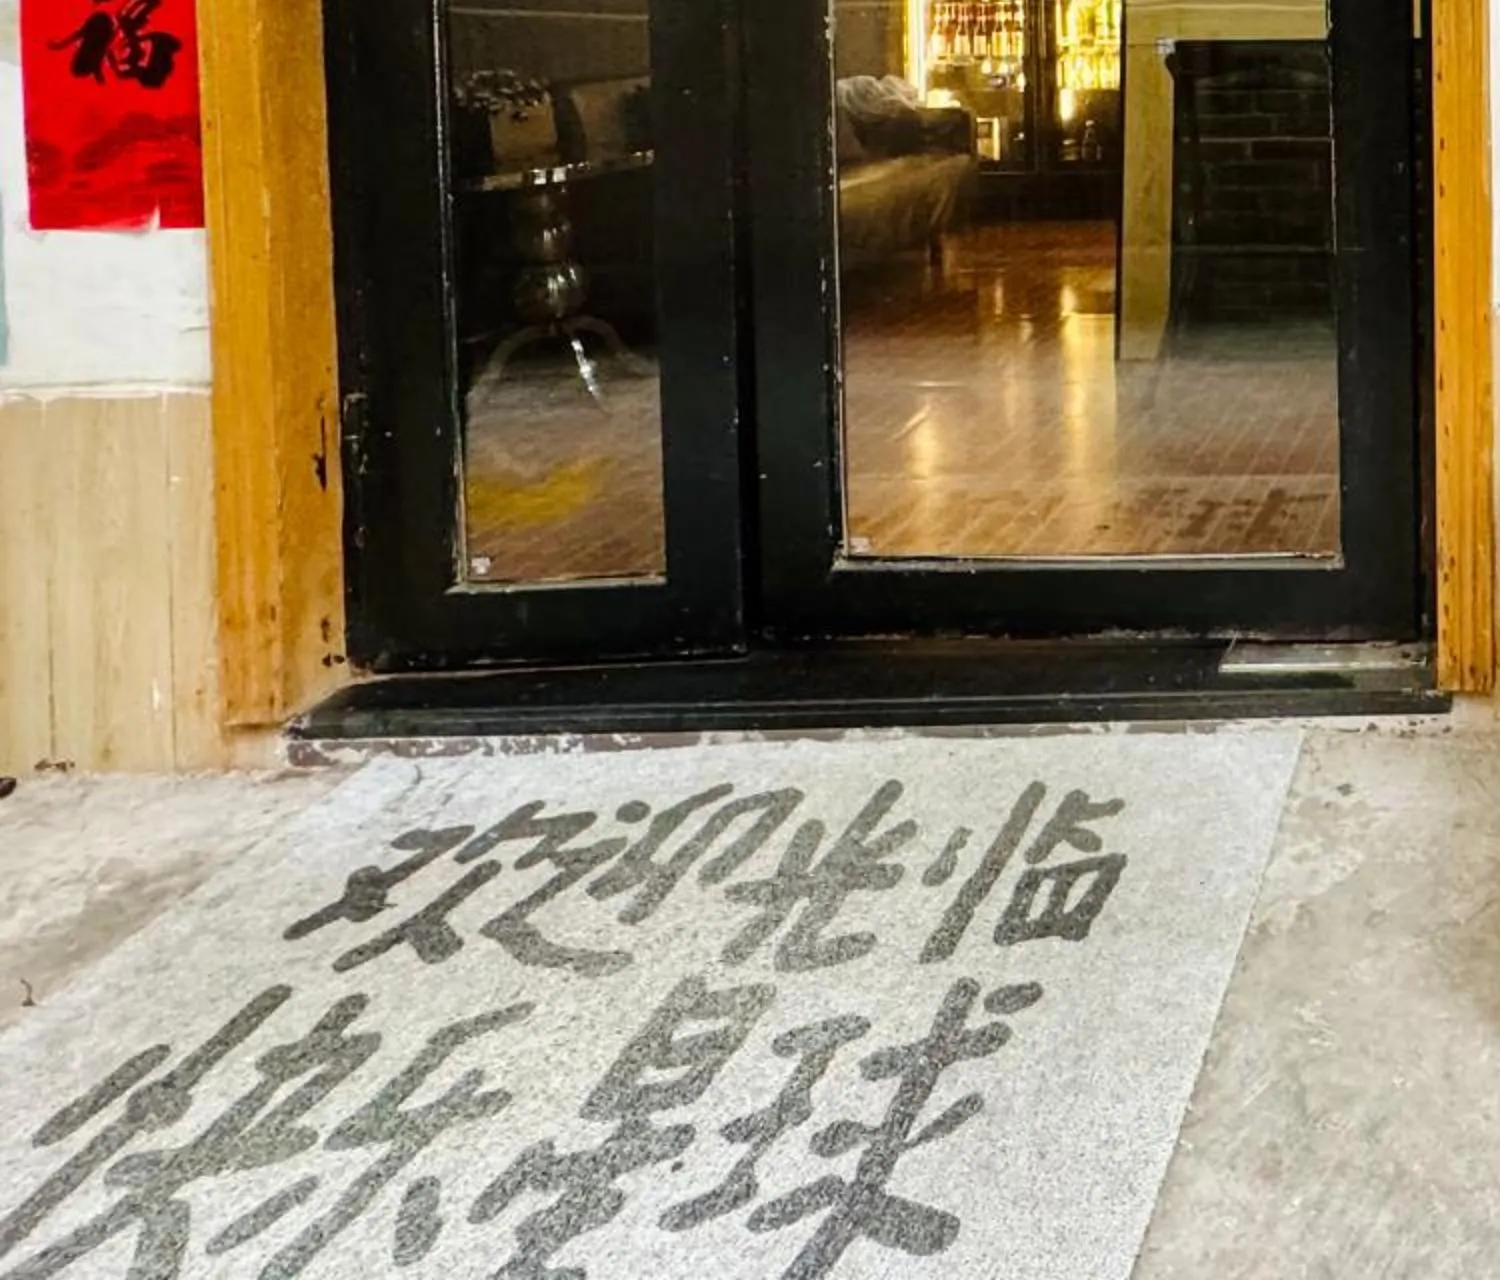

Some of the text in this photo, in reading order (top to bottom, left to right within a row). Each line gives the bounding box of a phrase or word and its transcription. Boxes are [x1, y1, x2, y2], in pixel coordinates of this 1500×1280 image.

[284, 779, 1128, 977] 欢迎光临
[0, 975, 1044, 1280] 快乐星球
